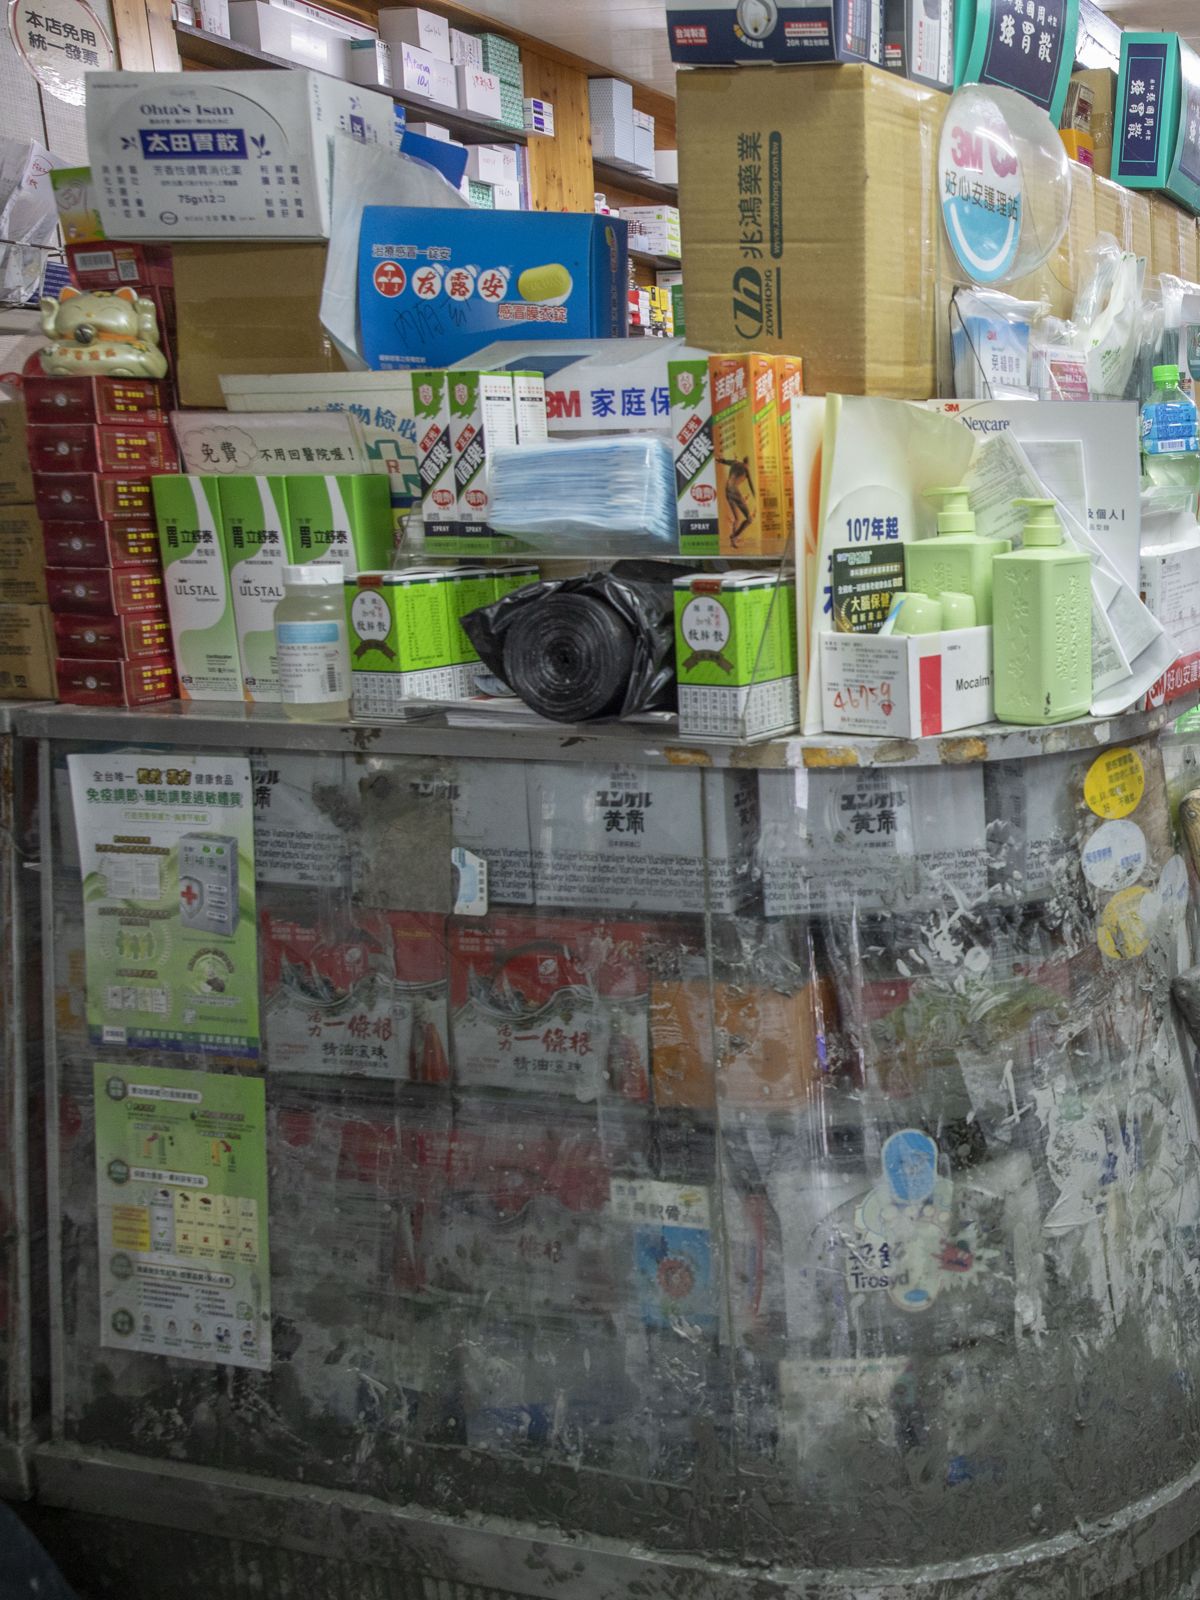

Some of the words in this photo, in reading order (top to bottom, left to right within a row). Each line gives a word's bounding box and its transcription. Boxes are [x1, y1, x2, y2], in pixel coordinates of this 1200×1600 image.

[25, 10, 97, 48] 本店免用
[28, 32, 101, 68] 統一發票
[141, 104, 191, 116] Ohta's
[197, 104, 235, 116] Isan
[147, 133, 239, 153] 太田胃散
[737, 131, 763, 259] 兆鴻藥業
[945, 168, 1019, 221] 好心安護理站
[372, 245, 451, 260] 治療感冒一錠安
[416, 270, 505, 299] 友露安
[497, 303, 568, 322] 感冒膜衣錠
[765, 270, 774, 336] ZOWHONG
[947, 403, 960, 412] 3M
[961, 416, 1010, 433] Nexcare
[200, 442, 239, 463] 免費
[847, 517, 898, 542] 107年起
[175, 585, 217, 596] ULSTAL
[240, 586, 283, 597] ULSTAL
[956, 673, 990, 691] Mocalm
[93, 771, 133, 782] 全台唯一
[195, 774, 233, 786] 健康食品
[594, 791, 652, 808] ユンケル
[840, 791, 905, 811] ユンケル
[848, 1271, 909, 1288] Trosyd
